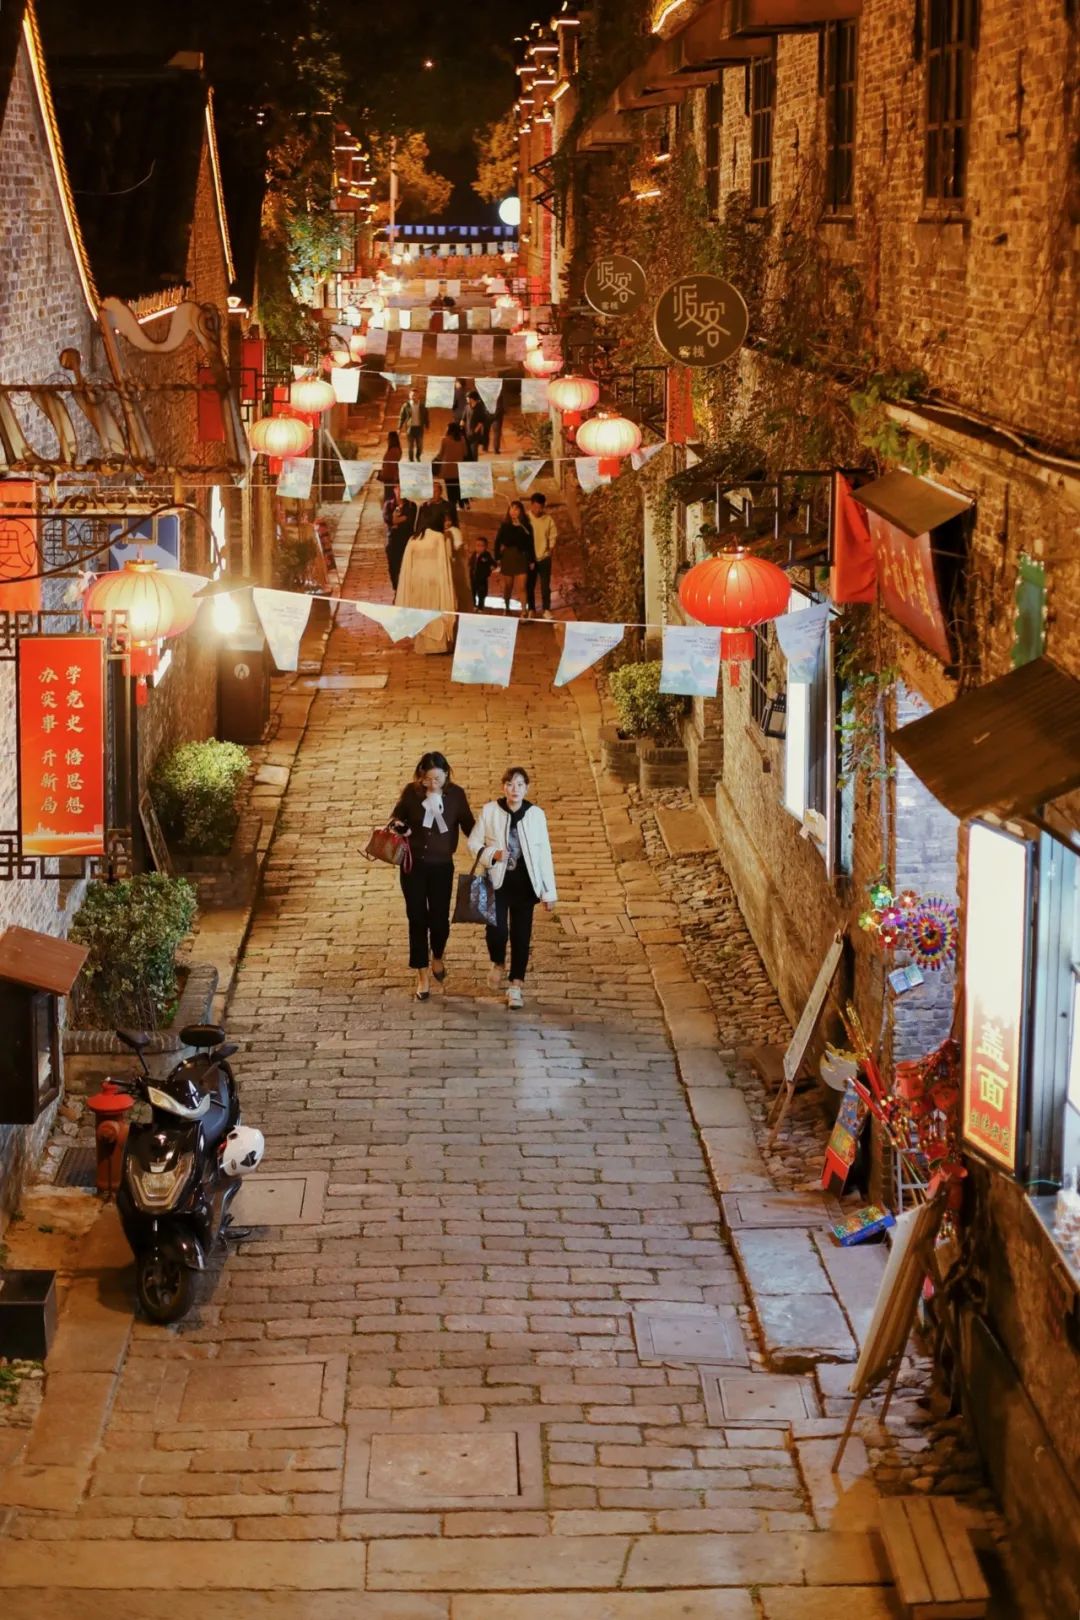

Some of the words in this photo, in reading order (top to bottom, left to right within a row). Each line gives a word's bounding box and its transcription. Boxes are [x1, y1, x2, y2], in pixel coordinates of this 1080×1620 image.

[38, 666, 60, 733] 办实事
[65, 665, 85, 733] 学党史
[40, 749, 60, 814] 开新局
[64, 748, 85, 814] 悟思想
